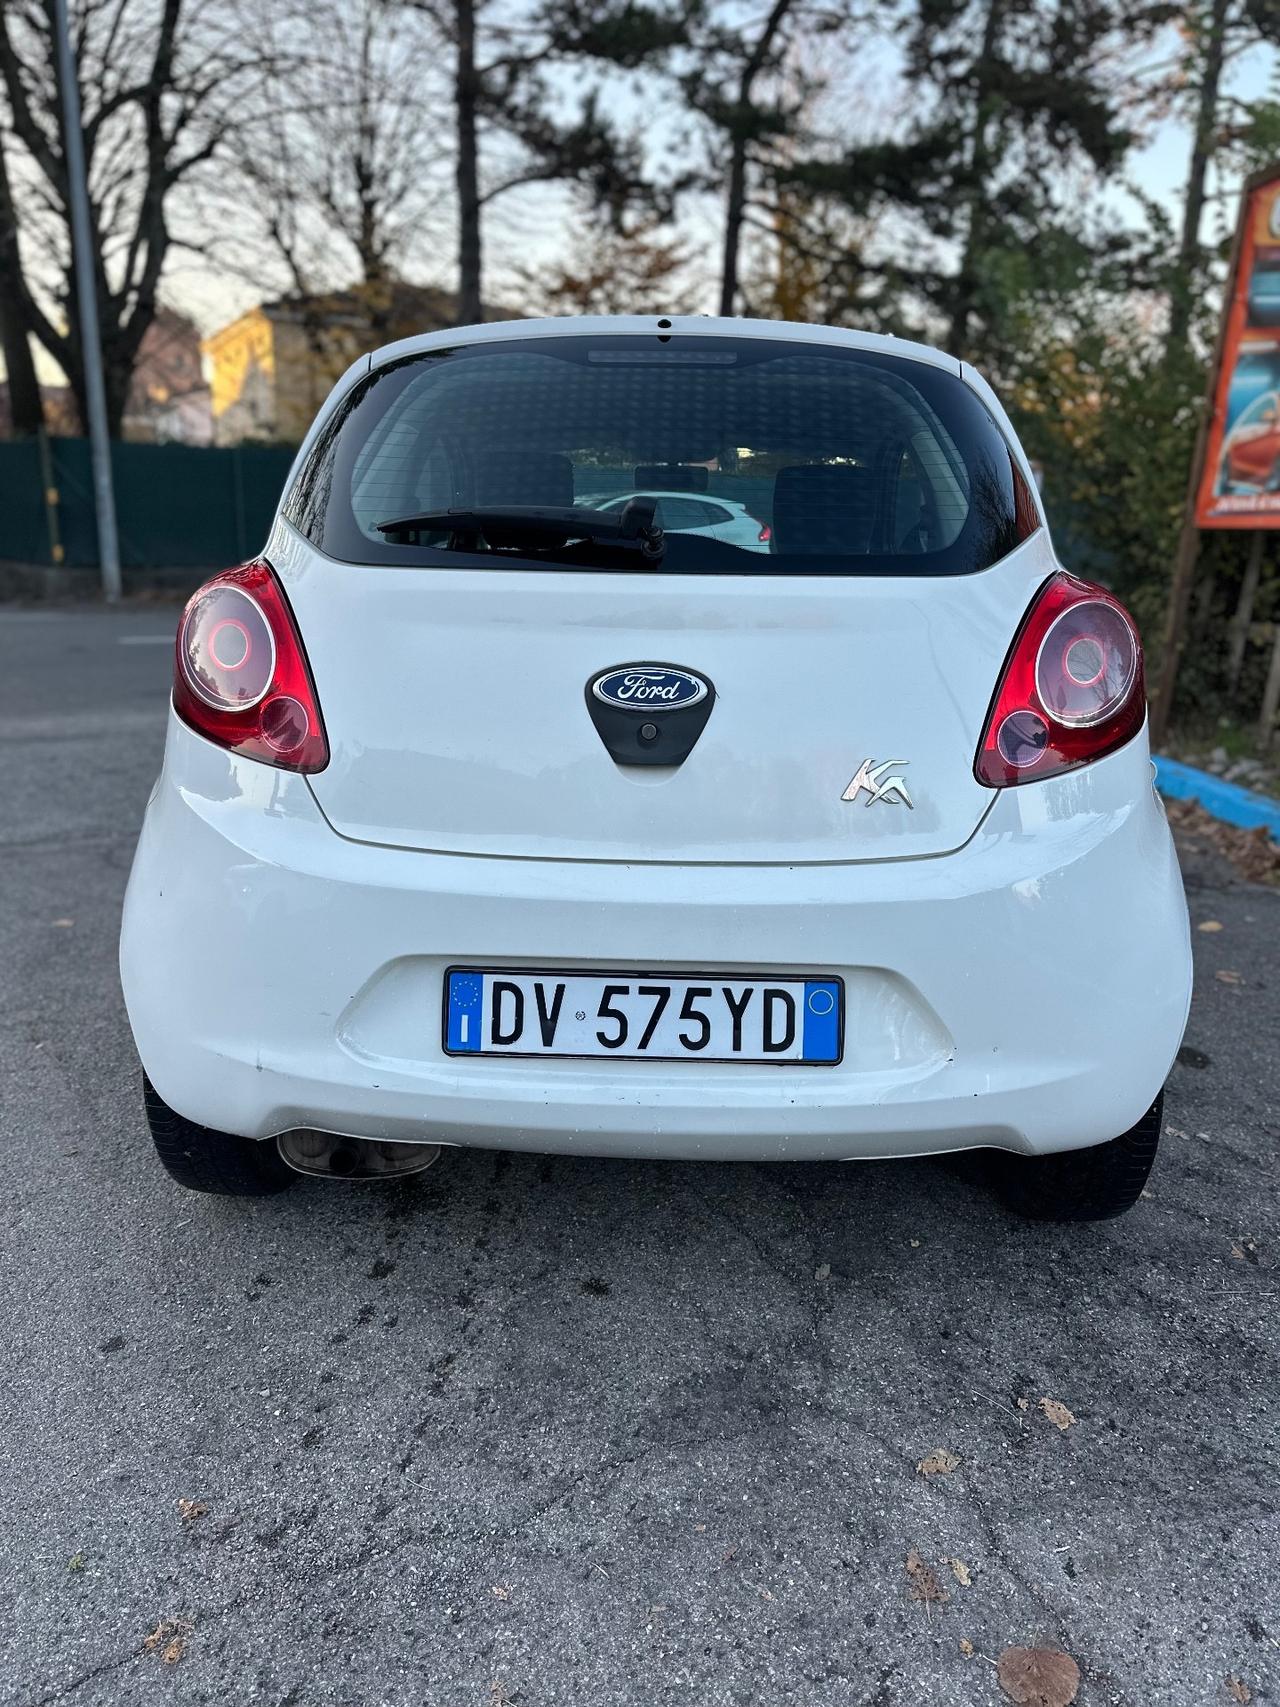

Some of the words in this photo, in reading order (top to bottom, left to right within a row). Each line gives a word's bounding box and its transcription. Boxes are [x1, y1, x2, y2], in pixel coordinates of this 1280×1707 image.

[617, 673, 681, 700] Ford
[460, 1014, 469, 1043] I
[491, 981, 566, 1047] DV
[596, 985, 796, 1053] 575YD
